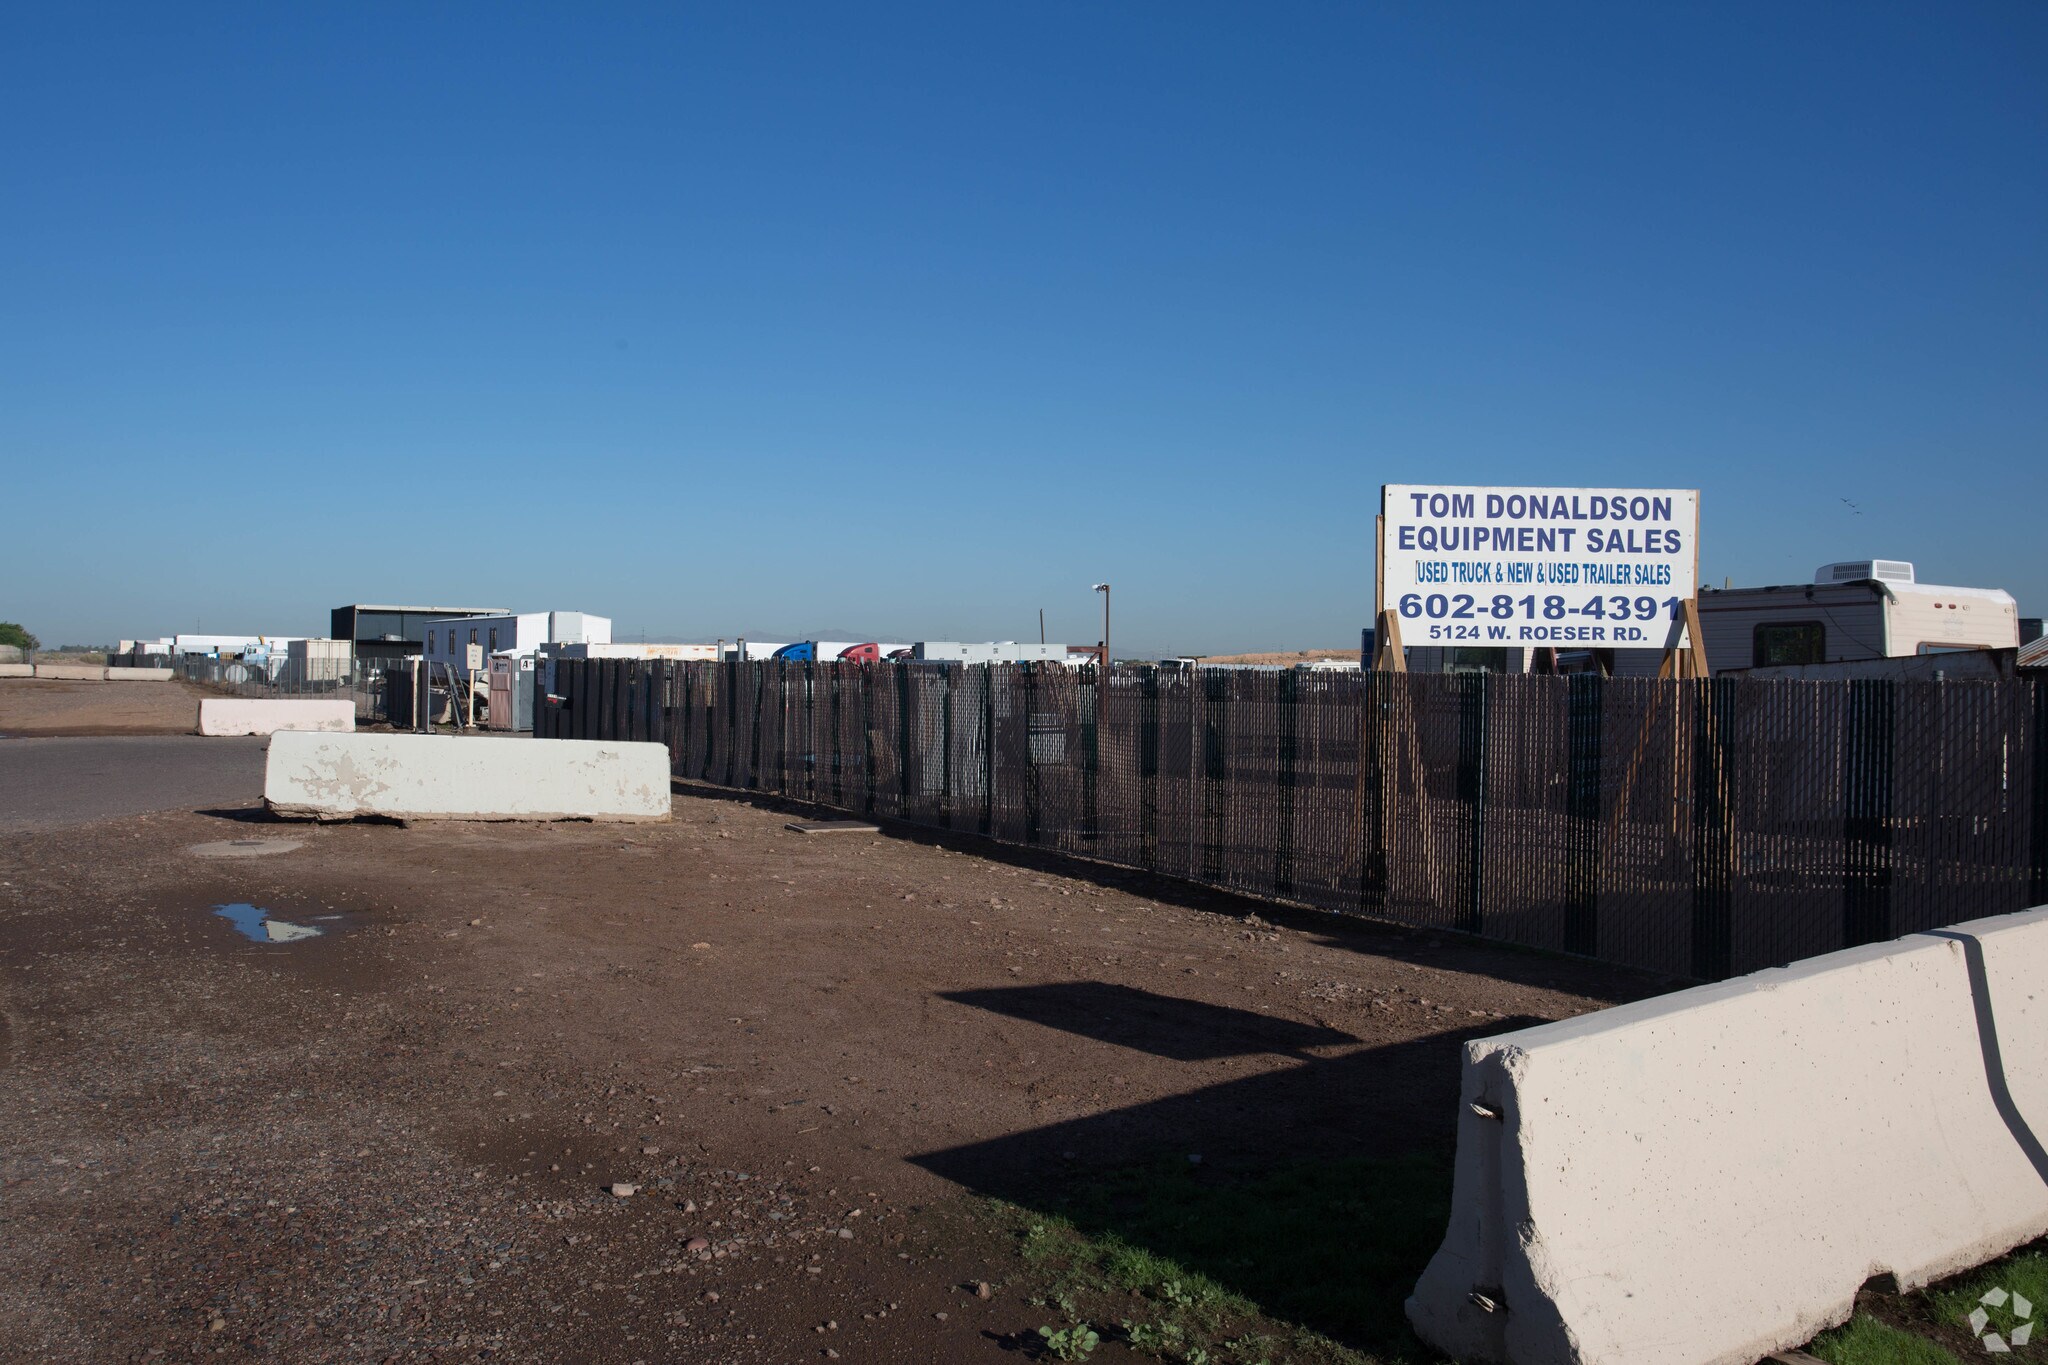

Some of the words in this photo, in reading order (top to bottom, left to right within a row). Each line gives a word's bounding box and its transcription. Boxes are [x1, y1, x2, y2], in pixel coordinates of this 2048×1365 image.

[1411, 493, 1474, 518] TOM
[1486, 495, 1672, 521] DONALDSON
[1399, 525, 1576, 553] EQUIPMENT
[1586, 528, 1681, 554] SALES
[1417, 562, 1448, 583] USED
[1452, 562, 1491, 584] TRUCK
[1495, 562, 1503, 584] &
[1507, 562, 1533, 584] NEW
[1537, 563, 1545, 584] &
[1548, 563, 1579, 584] USED
[1582, 563, 1632, 584] TRAILER
[1634, 564, 1671, 585] SALES
[1399, 593, 1680, 621] 602-818-4391
[1429, 625, 1480, 640] 5124
[1487, 626, 1511, 640] W.
[1519, 626, 1606, 641] ROESER
[1613, 626, 1648, 641] RD.
